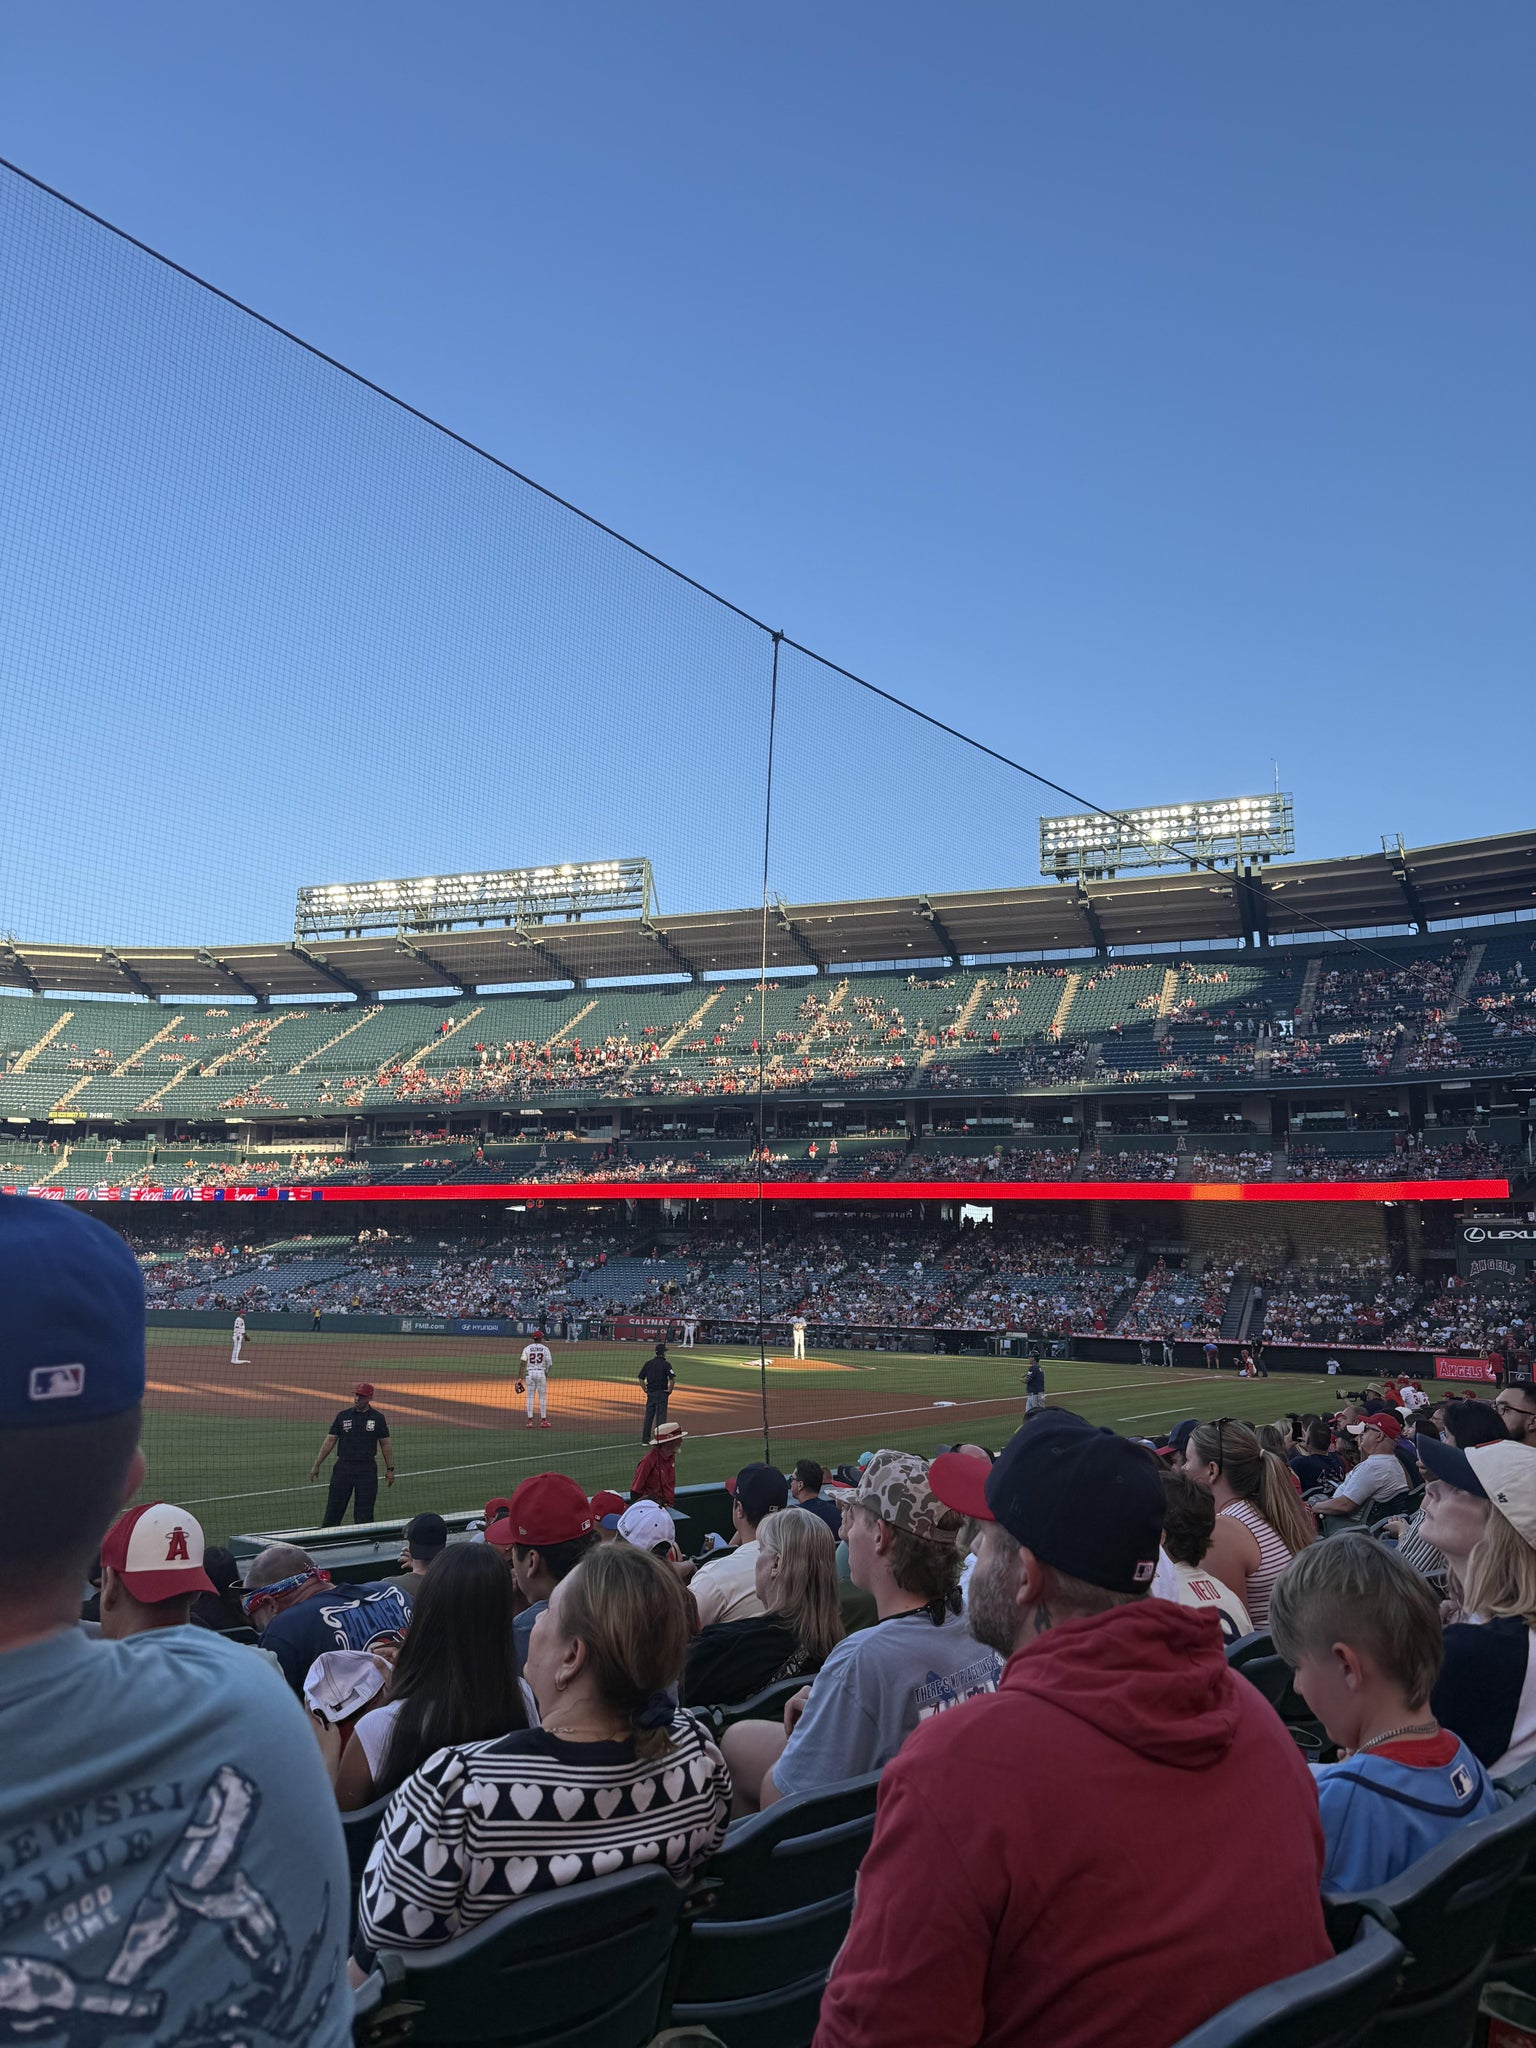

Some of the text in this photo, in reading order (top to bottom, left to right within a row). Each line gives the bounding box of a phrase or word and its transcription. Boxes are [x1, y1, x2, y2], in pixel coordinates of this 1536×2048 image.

[1487, 1230, 1536, 1239] LEXU
[1469, 1259, 1517, 1277] ANGELS
[472, 1324, 499, 1332] HYUNDAI
[529, 1353, 544, 1364] 23
[1440, 1360, 1483, 1378] ANGELS
[165, 1526, 190, 1561] A
[1188, 1580, 1221, 1601] NETO
[0, 1782, 185, 1880] EWSKI
[45, 1884, 112, 1934] GOOD
[53, 1905, 120, 1951] TIME
